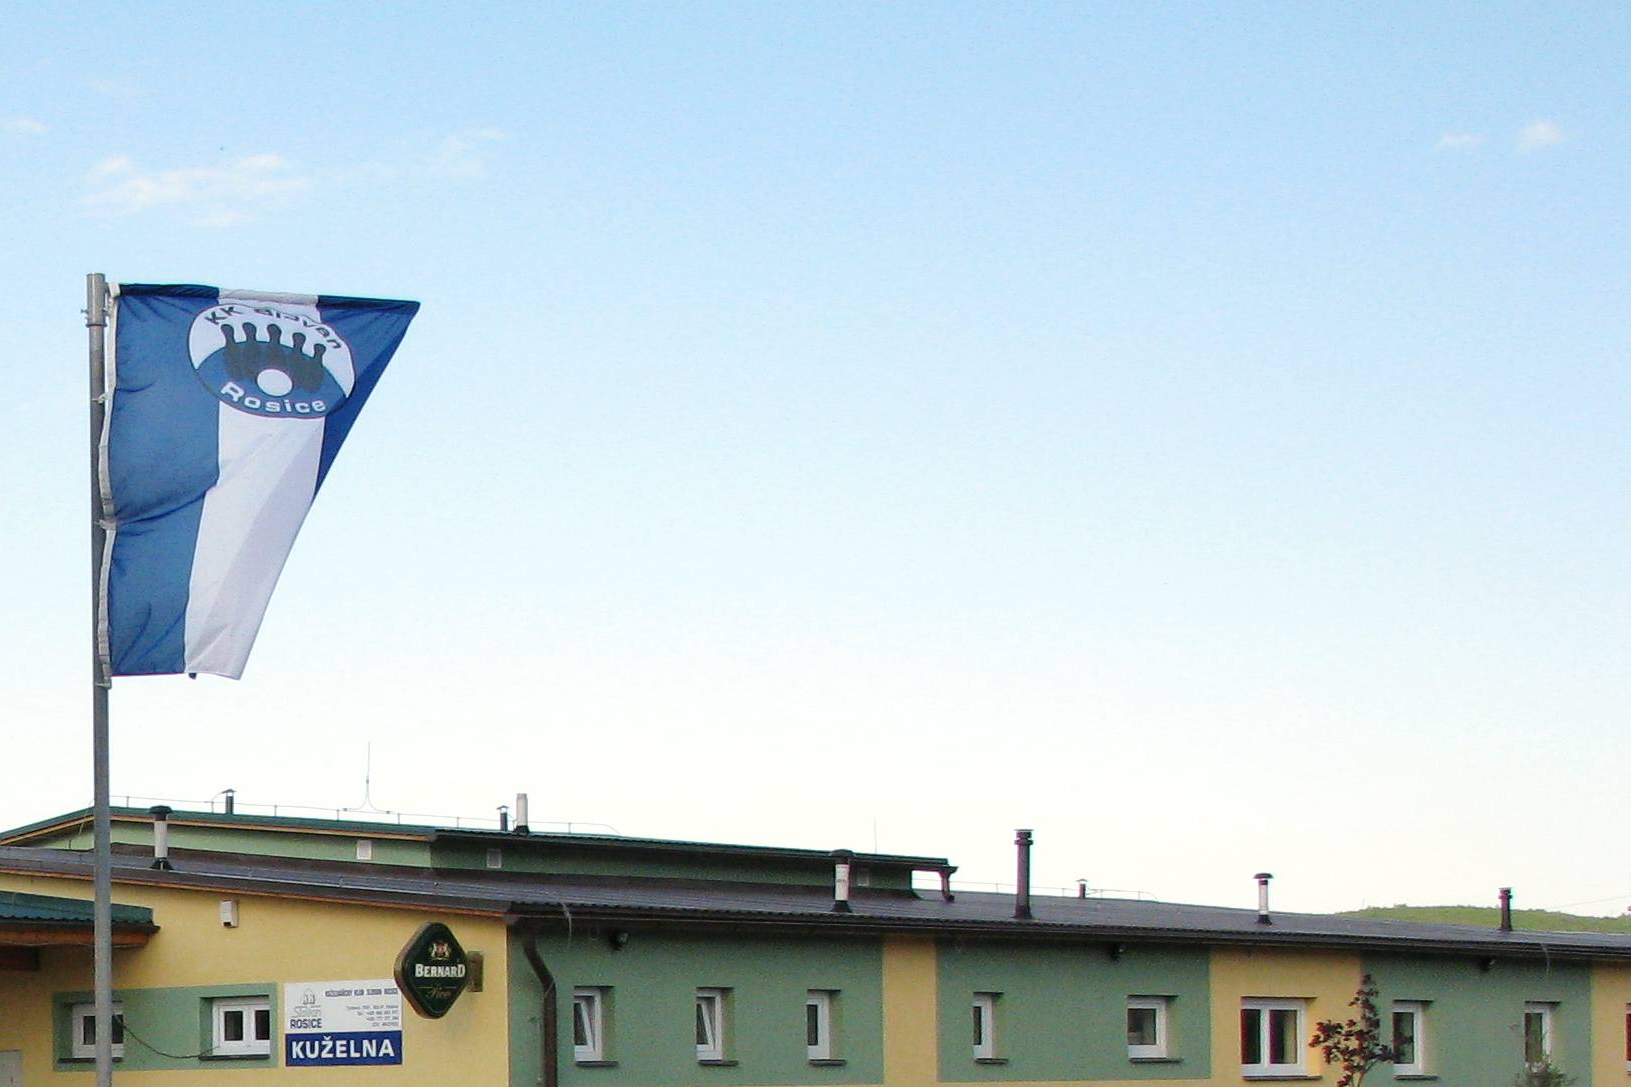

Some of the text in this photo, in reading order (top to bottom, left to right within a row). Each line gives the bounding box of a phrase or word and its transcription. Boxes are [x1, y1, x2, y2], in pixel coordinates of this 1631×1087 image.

[204, 306, 244, 325] KK
[220, 382, 327, 414] Rosice
[415, 963, 466, 978] BERNARD
[290, 1018, 323, 1029] ROSICE
[291, 1035, 396, 1060] KUŽELNA
